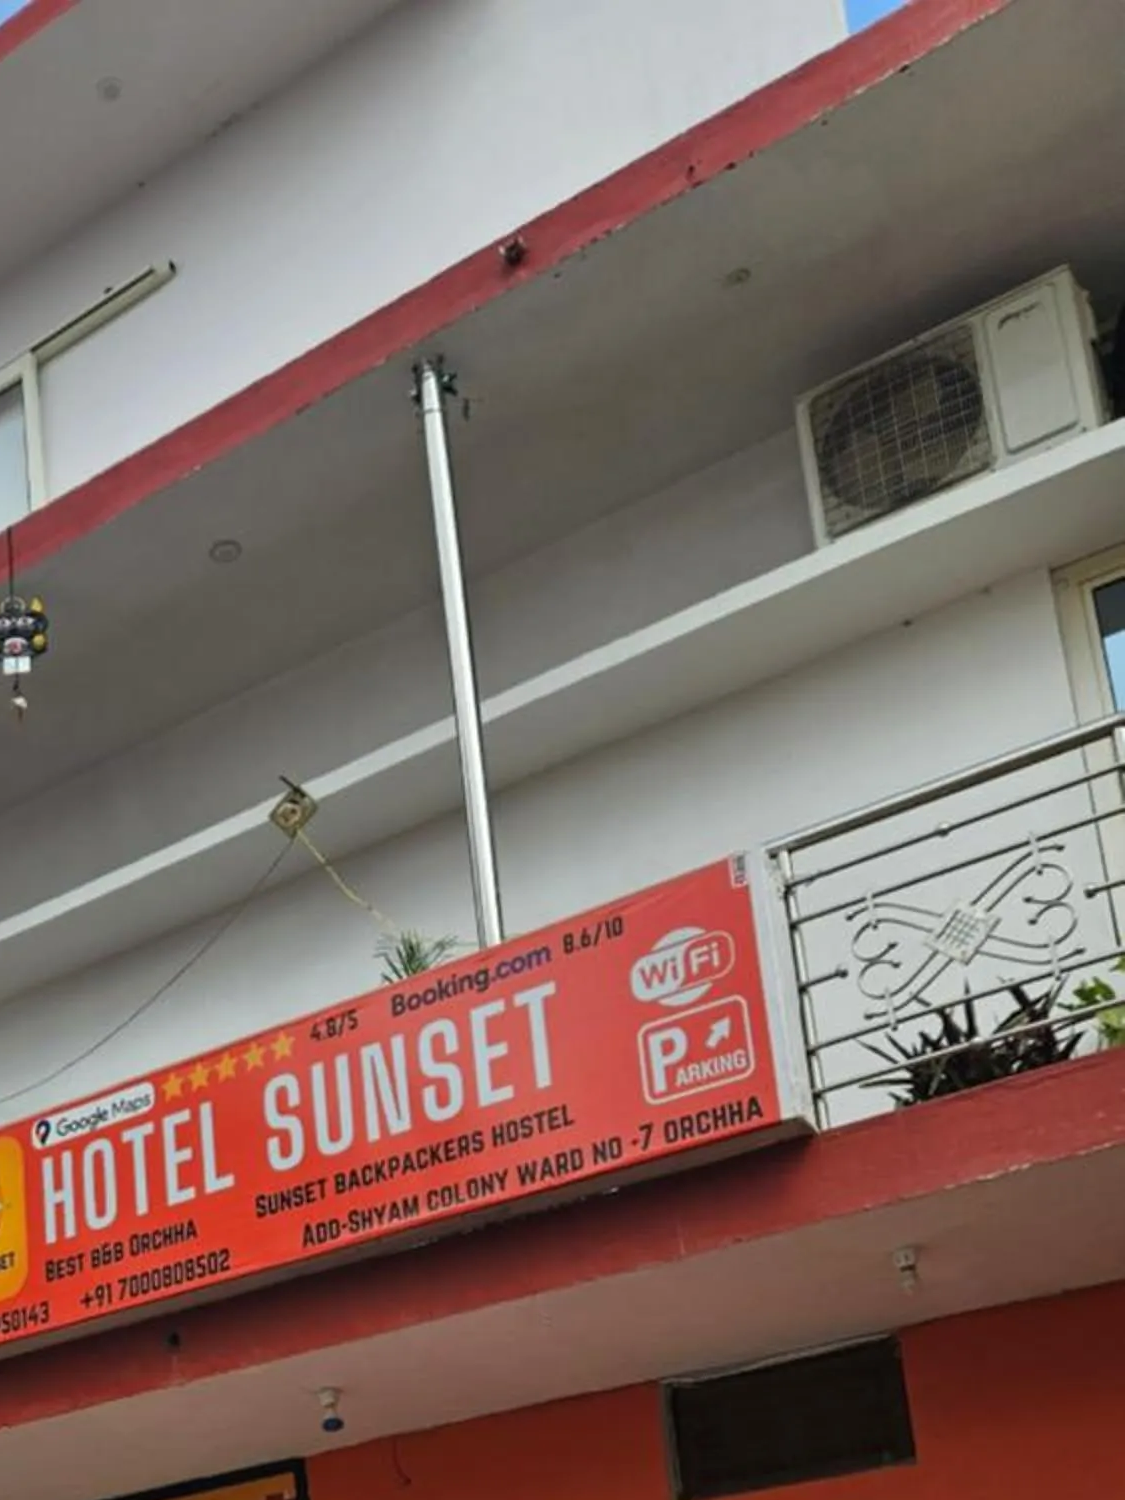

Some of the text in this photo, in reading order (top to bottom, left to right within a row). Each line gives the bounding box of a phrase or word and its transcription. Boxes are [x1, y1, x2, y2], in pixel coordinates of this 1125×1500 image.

[390, 917, 625, 1017] Booking.com 8.6/10
[42, 980, 556, 1245] HOTEL SUNSET
[56, 1009, 359, 1136] Google Maps 4.8/5
[255, 1103, 575, 1218] SUNSET BACKPACKERS HOSTEL
[302, 1195, 420, 1248] ADD-SHYAM
[427, 1168, 509, 1213] COLONY
[516, 1149, 584, 1185] WARD
[591, 1136, 623, 1166] NO
[663, 1096, 765, 1144] ORCHHA
[45, 1219, 198, 1283] BEST B&B ORCHHA
[80, 1282, 112, 1309] +91
